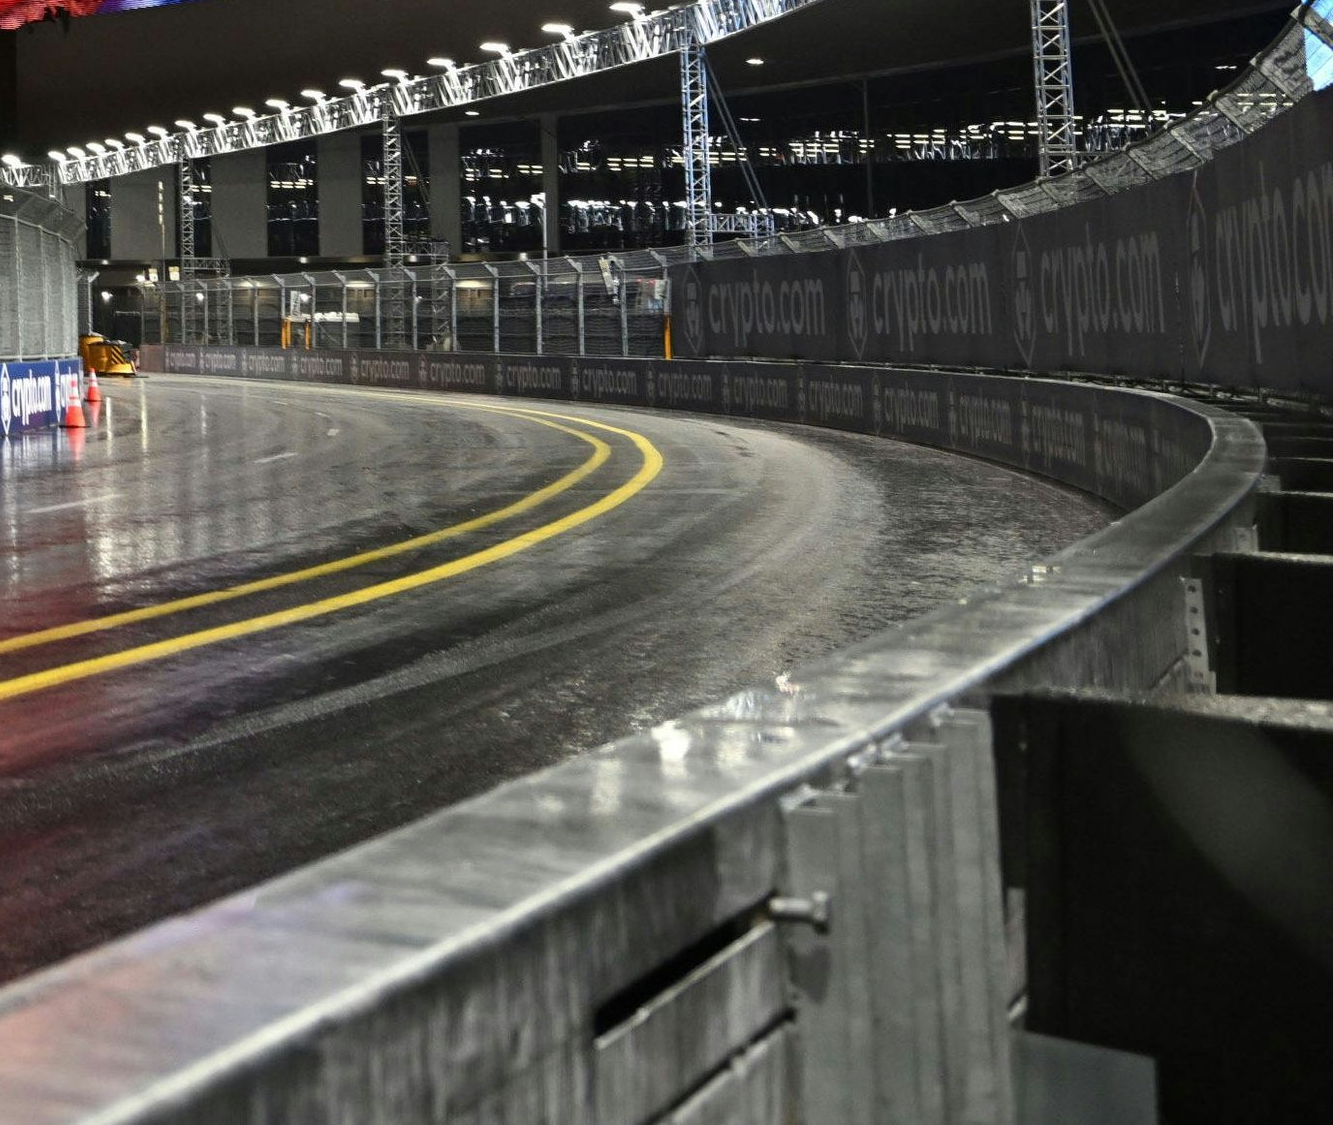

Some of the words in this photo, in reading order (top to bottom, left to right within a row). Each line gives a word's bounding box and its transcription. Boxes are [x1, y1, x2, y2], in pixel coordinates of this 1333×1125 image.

[873, 253, 992, 352] crypto.com
[1041, 222, 1165, 357] crypto.com
[708, 269, 825, 348] crypto.com
[360, 357, 410, 381] crypto.com
[431, 359, 486, 386] crypto.com
[507, 361, 562, 391] crypto.com
[582, 363, 637, 396] crypto.com
